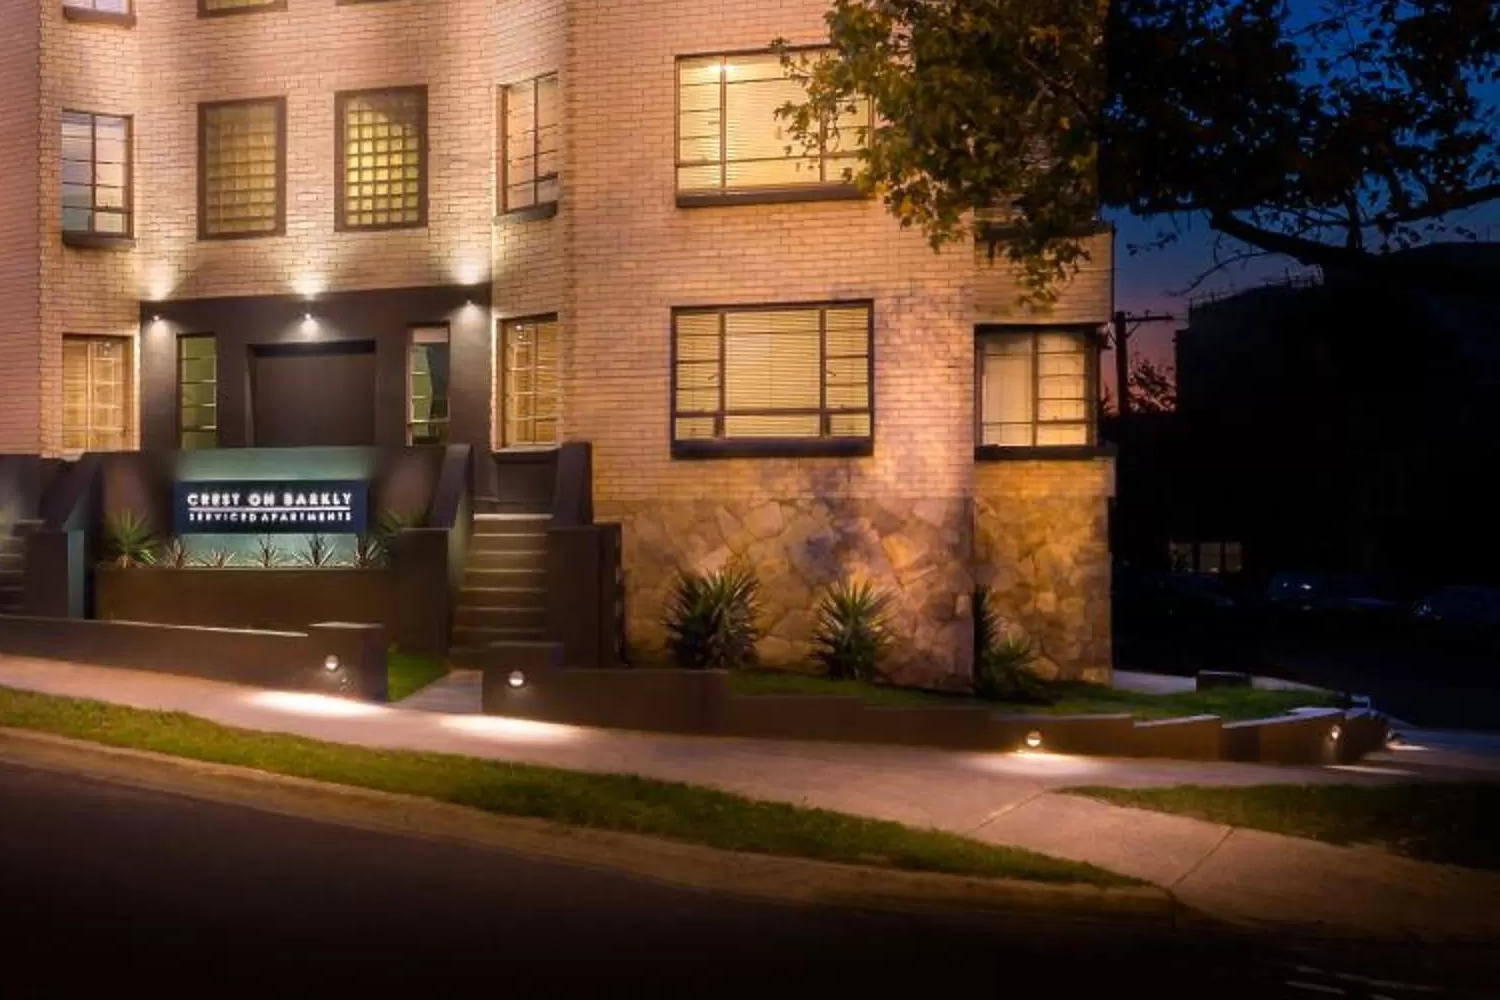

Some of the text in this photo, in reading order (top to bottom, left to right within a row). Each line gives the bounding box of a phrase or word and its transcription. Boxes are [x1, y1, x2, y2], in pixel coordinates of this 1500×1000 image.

[187, 492, 352, 506] CREST ON BARKLY
[189, 511, 352, 522] SERVICED APARTMENTS
